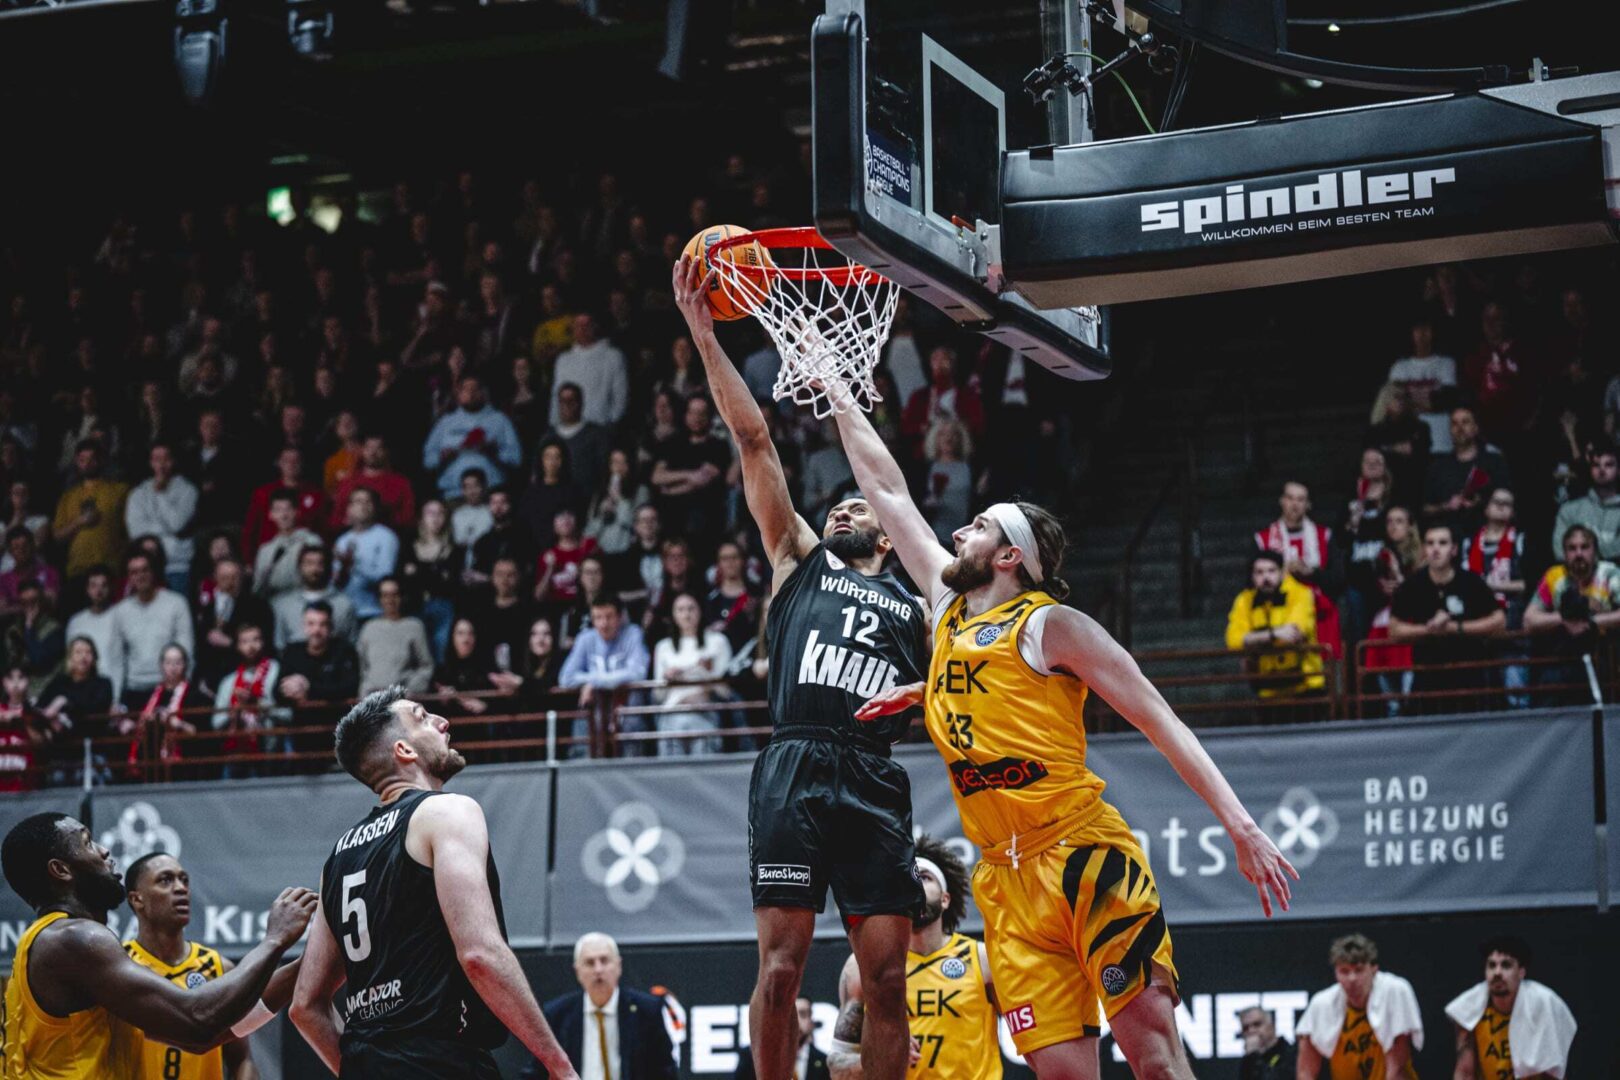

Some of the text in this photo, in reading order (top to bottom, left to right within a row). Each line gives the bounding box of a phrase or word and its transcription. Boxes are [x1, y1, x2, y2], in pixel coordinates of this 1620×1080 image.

[872, 144, 906, 175] BASKETBALL
[873, 158, 910, 193] CHAMPIONS
[1140, 167, 1456, 234] spindler
[1201, 206, 1435, 242] WILLKOMMEN BEIM BESTEN TEAM
[820, 574, 912, 622] WÜRZBURG
[841, 605, 880, 648] 12
[798, 629, 900, 700] KNAUF
[1364, 775, 1428, 804] BAD
[1364, 802, 1509, 836] HEIZUNG
[1364, 835, 1506, 868] ENERGIE
[341, 869, 372, 963] 5
[162, 1047, 182, 1080] 8
